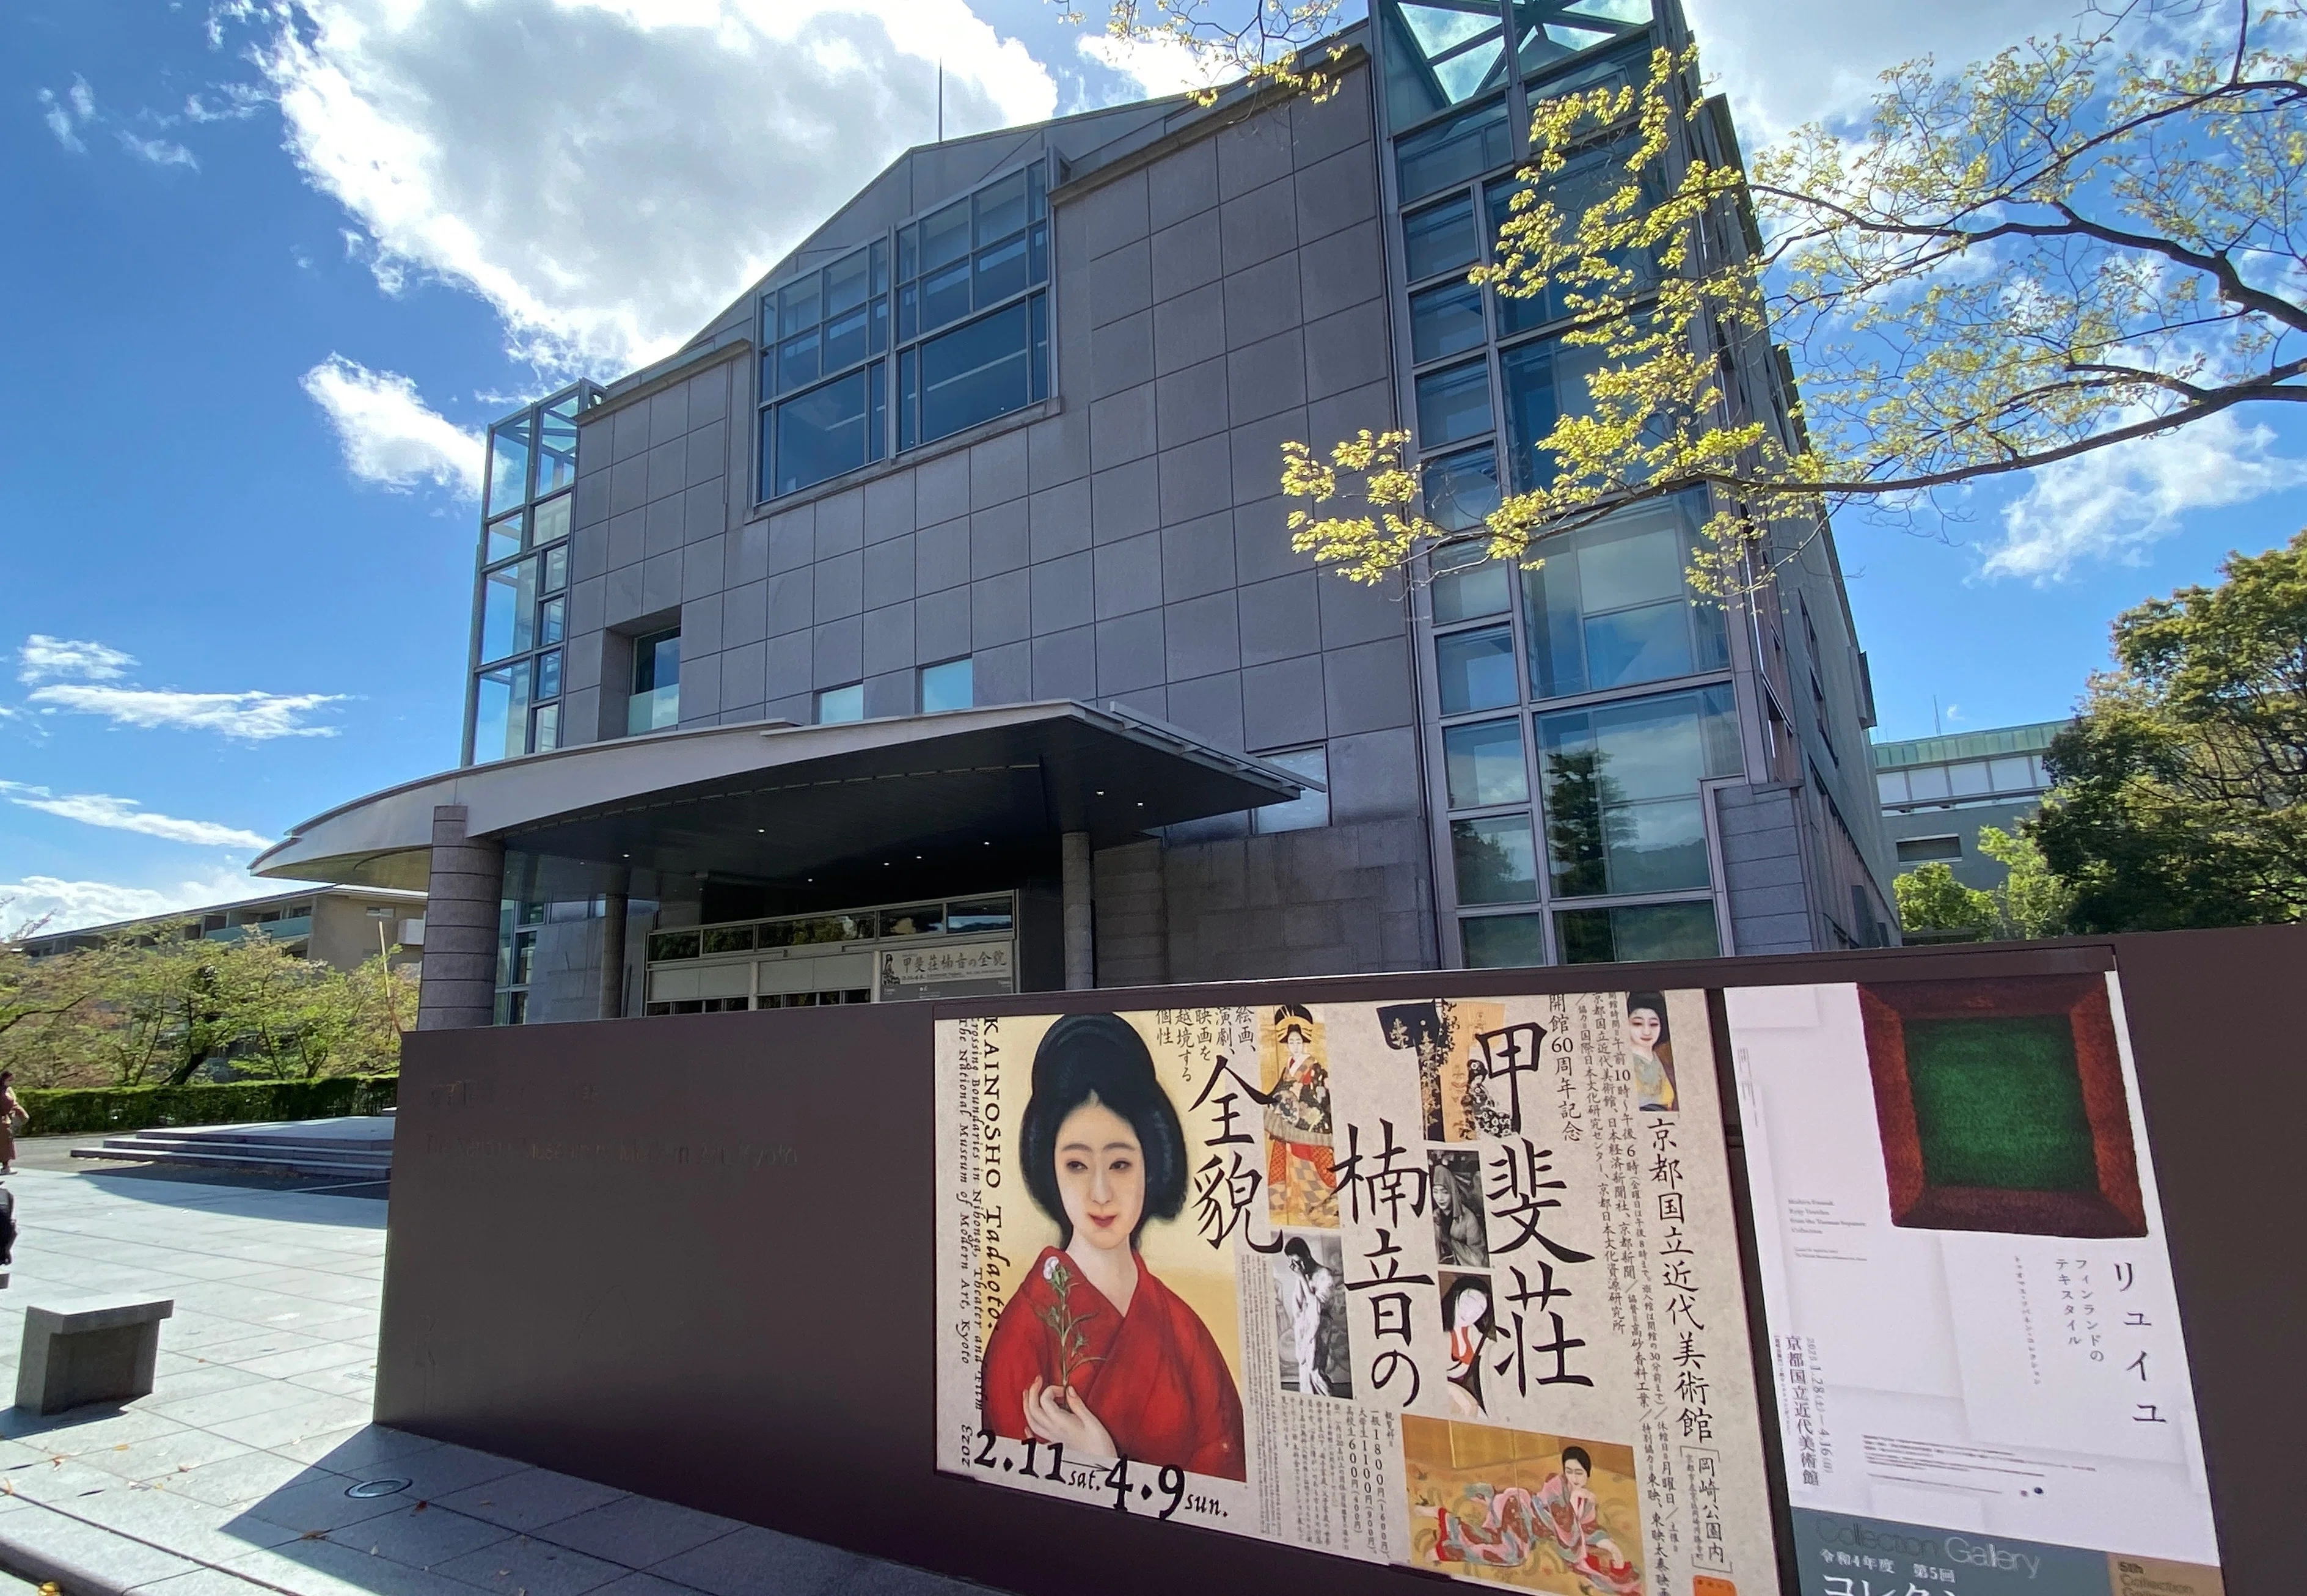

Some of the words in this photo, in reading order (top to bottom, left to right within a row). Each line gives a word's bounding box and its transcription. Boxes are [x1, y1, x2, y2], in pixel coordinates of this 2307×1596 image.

[959, 1019, 971, 1042] The
[1155, 1009, 1174, 1046] 個性
[1175, 1009, 1194, 1082] 越境する
[1196, 1008, 1213, 1061] 映画を
[959, 1049, 972, 1116] National
[1549, 994, 1584, 1141] 開館60周年記念
[971, 1079, 984, 1159] Boundaries
[984, 1017, 1001, 1188] KAINOSHO
[959, 1124, 968, 1183] Museum
[973, 1168, 984, 1181] in
[956, 1192, 972, 1207] of
[960, 1212, 973, 1269] Modern
[960, 1278, 970, 1309] Art,
[974, 1267, 987, 1328] Theater
[1647, 1118, 1713, 1444] 京都国立近代美術館
[2055, 1258, 2082, 1345] テキスタイル
[956, 1320, 970, 1363] Kyoto
[974, 1335, 987, 1367] and
[961, 1424, 973, 1468] 2023
[1185, 1493, 1228, 1518] sun.
[1815, 1518, 1938, 1557] Collection
[1945, 1536, 2041, 1579] Gallery
[1820, 1548, 1895, 1574] 令和4年度
[1913, 1562, 1956, 1583] 第5回
